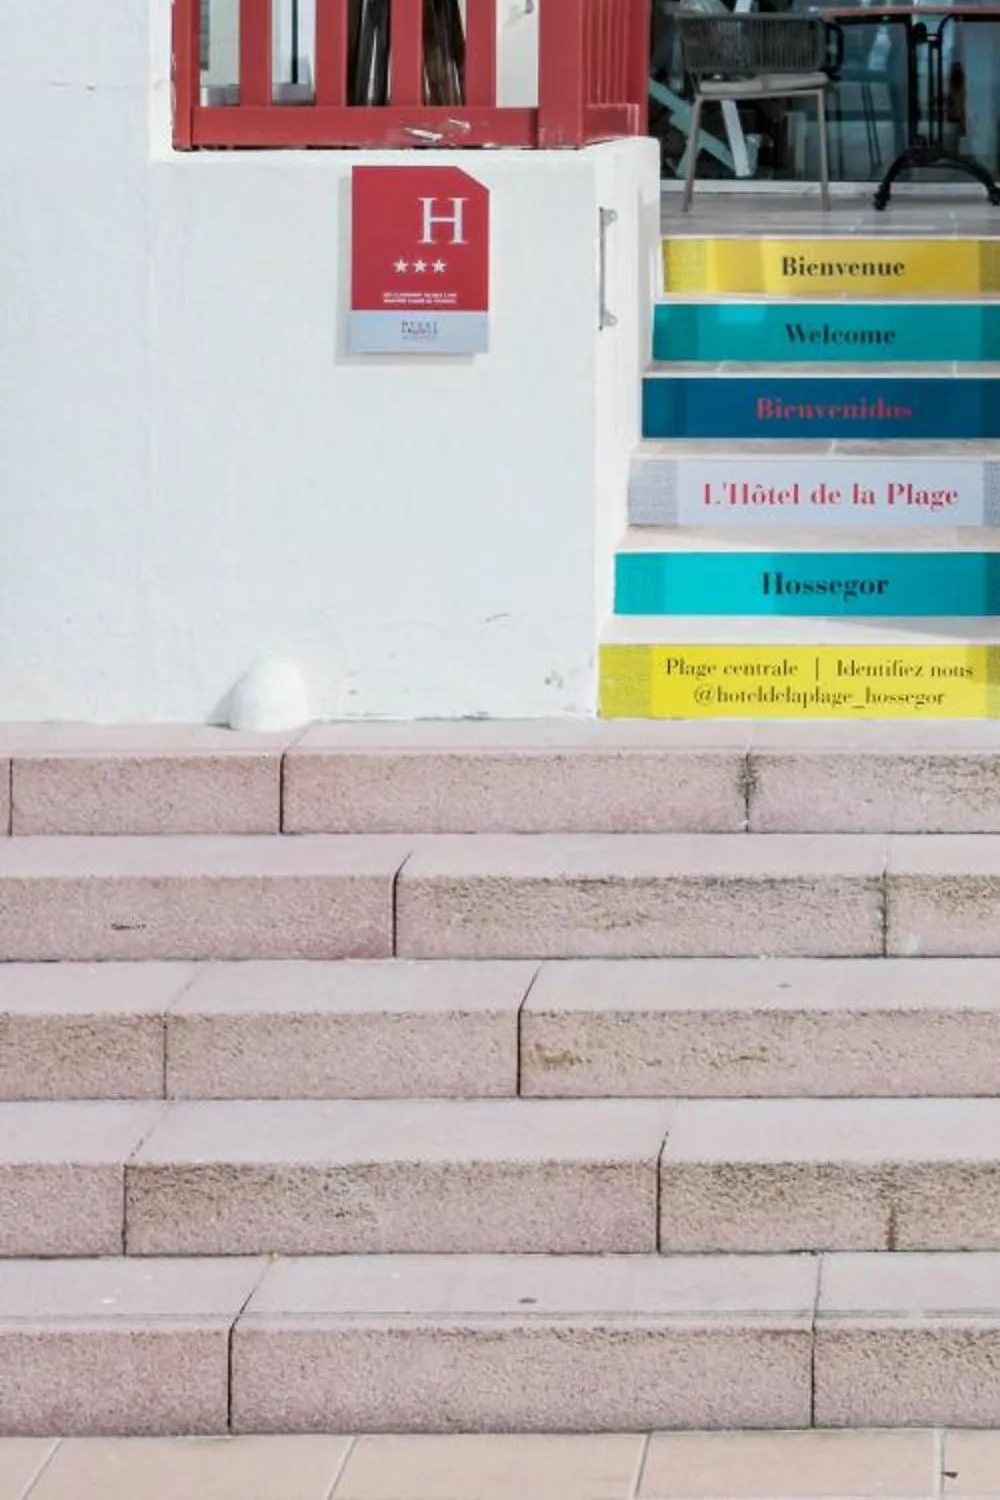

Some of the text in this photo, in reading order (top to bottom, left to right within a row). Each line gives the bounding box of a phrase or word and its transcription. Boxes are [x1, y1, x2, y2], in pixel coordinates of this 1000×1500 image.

[417, 197, 468, 245] H
[781, 256, 906, 277] Bienvenue
[784, 323, 897, 345] Welcome
[756, 398, 913, 420] Bienvenidos
[703, 482, 959, 511] L'Hôtel de la Plage
[762, 571, 890, 602] Hossegor
[664, 657, 974, 681] Plage centrale Identifiez nous
[693, 685, 945, 710] @hoteldelaplage_hossegor
